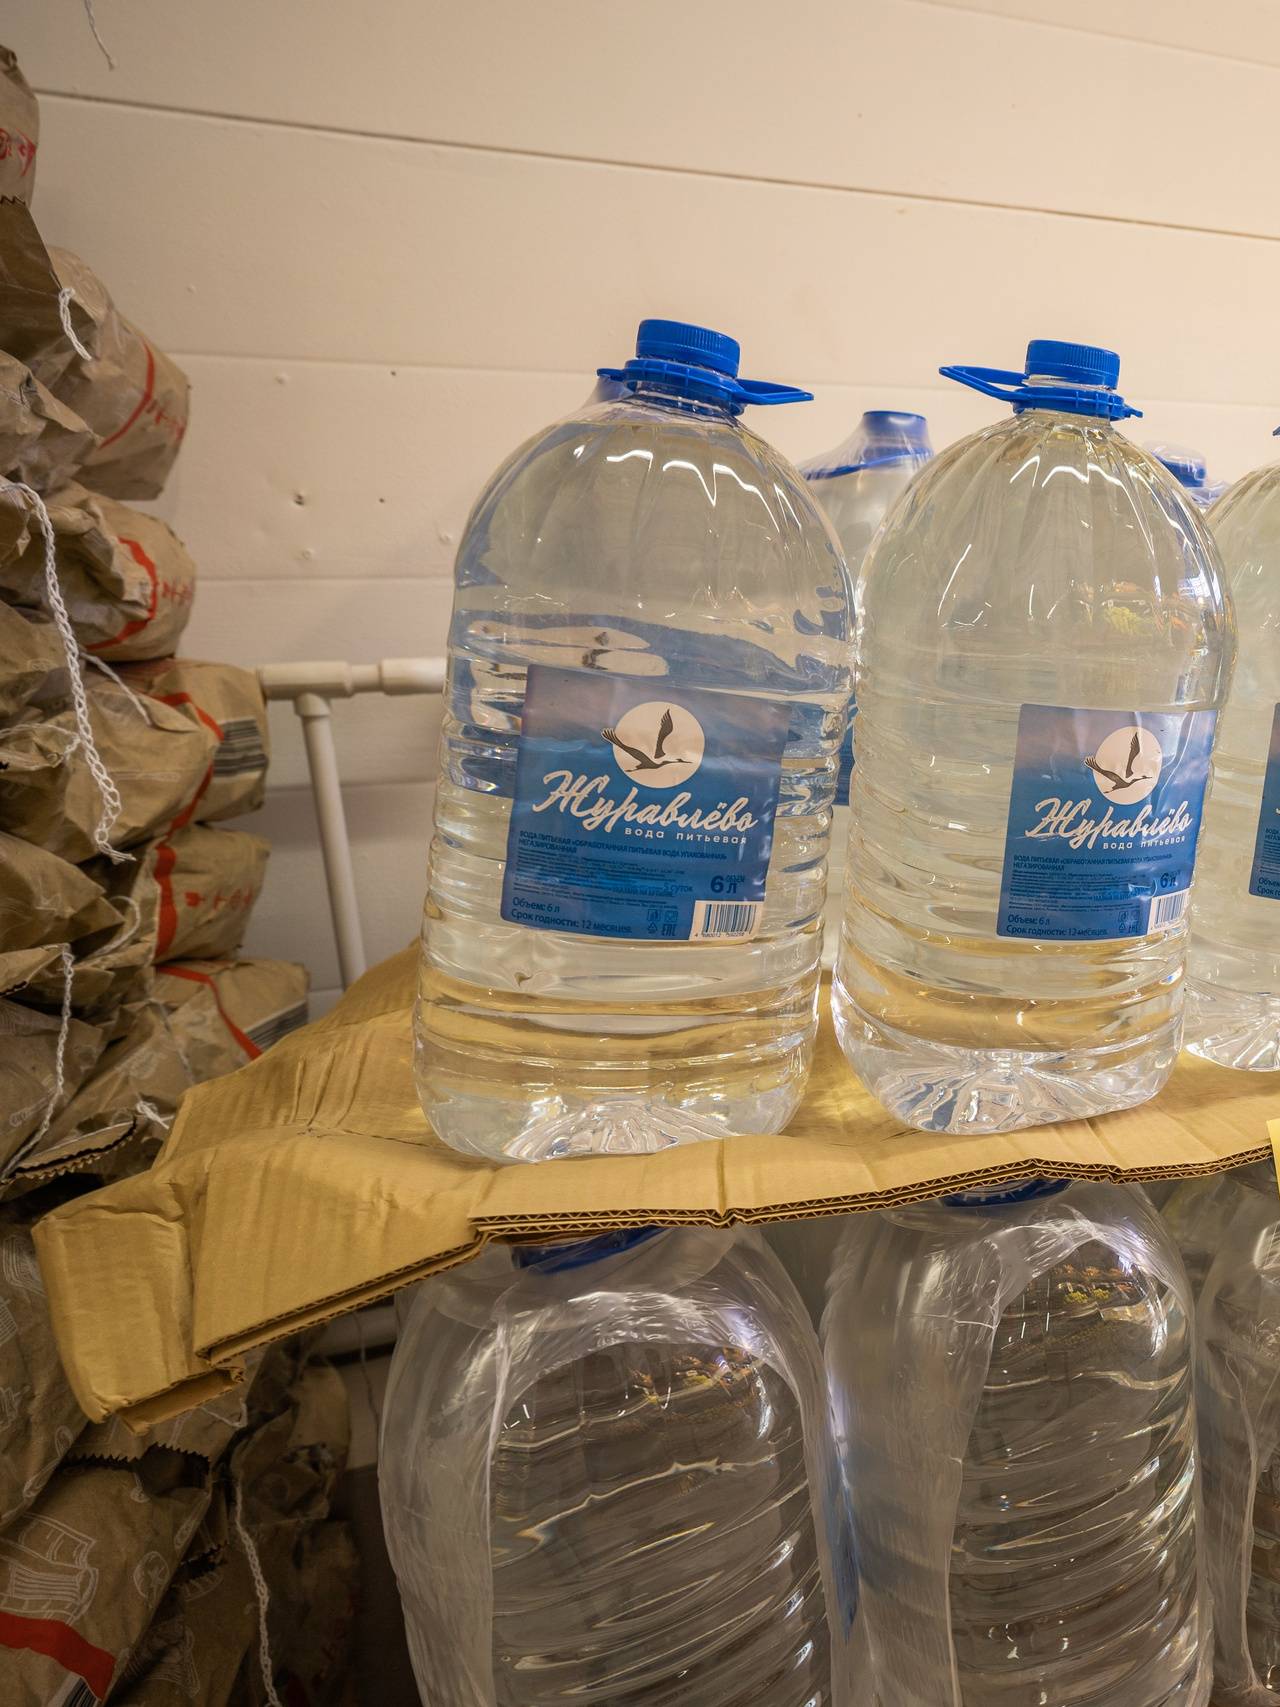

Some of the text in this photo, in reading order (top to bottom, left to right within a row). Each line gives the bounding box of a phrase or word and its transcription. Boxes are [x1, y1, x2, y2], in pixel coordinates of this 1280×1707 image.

[532, 770, 759, 833] Журавлёво
[1025, 797, 1193, 850] Журавлёво
[519, 830, 537, 840] ВОДА
[538, 833, 571, 845] ПИТЬЕВАЯ
[662, 850, 680, 858] ВОДА
[625, 827, 747, 845] вода питьевая
[1103, 835, 1186, 850] вода питьевая
[518, 838, 578, 854] НЕГАЗИРОВАННАЯ
[1013, 862, 1065, 872] НЕГАЗИРОВАННАЯ
[710, 875, 737, 894] 6 л
[1160, 872, 1169, 888] 6
[670, 885, 694, 893] суток
[512, 897, 546, 911] Объем:
[547, 903, 553, 912] 6
[511, 909, 533, 920] Срок
[534, 914, 579, 928] годности:
[581, 920, 591, 929] 12
[1008, 914, 1038, 924] Объем:
[1006, 924, 1028, 934] Срок
[1028, 927, 1066, 936] годности:
[1068, 928, 1076, 936] 12
